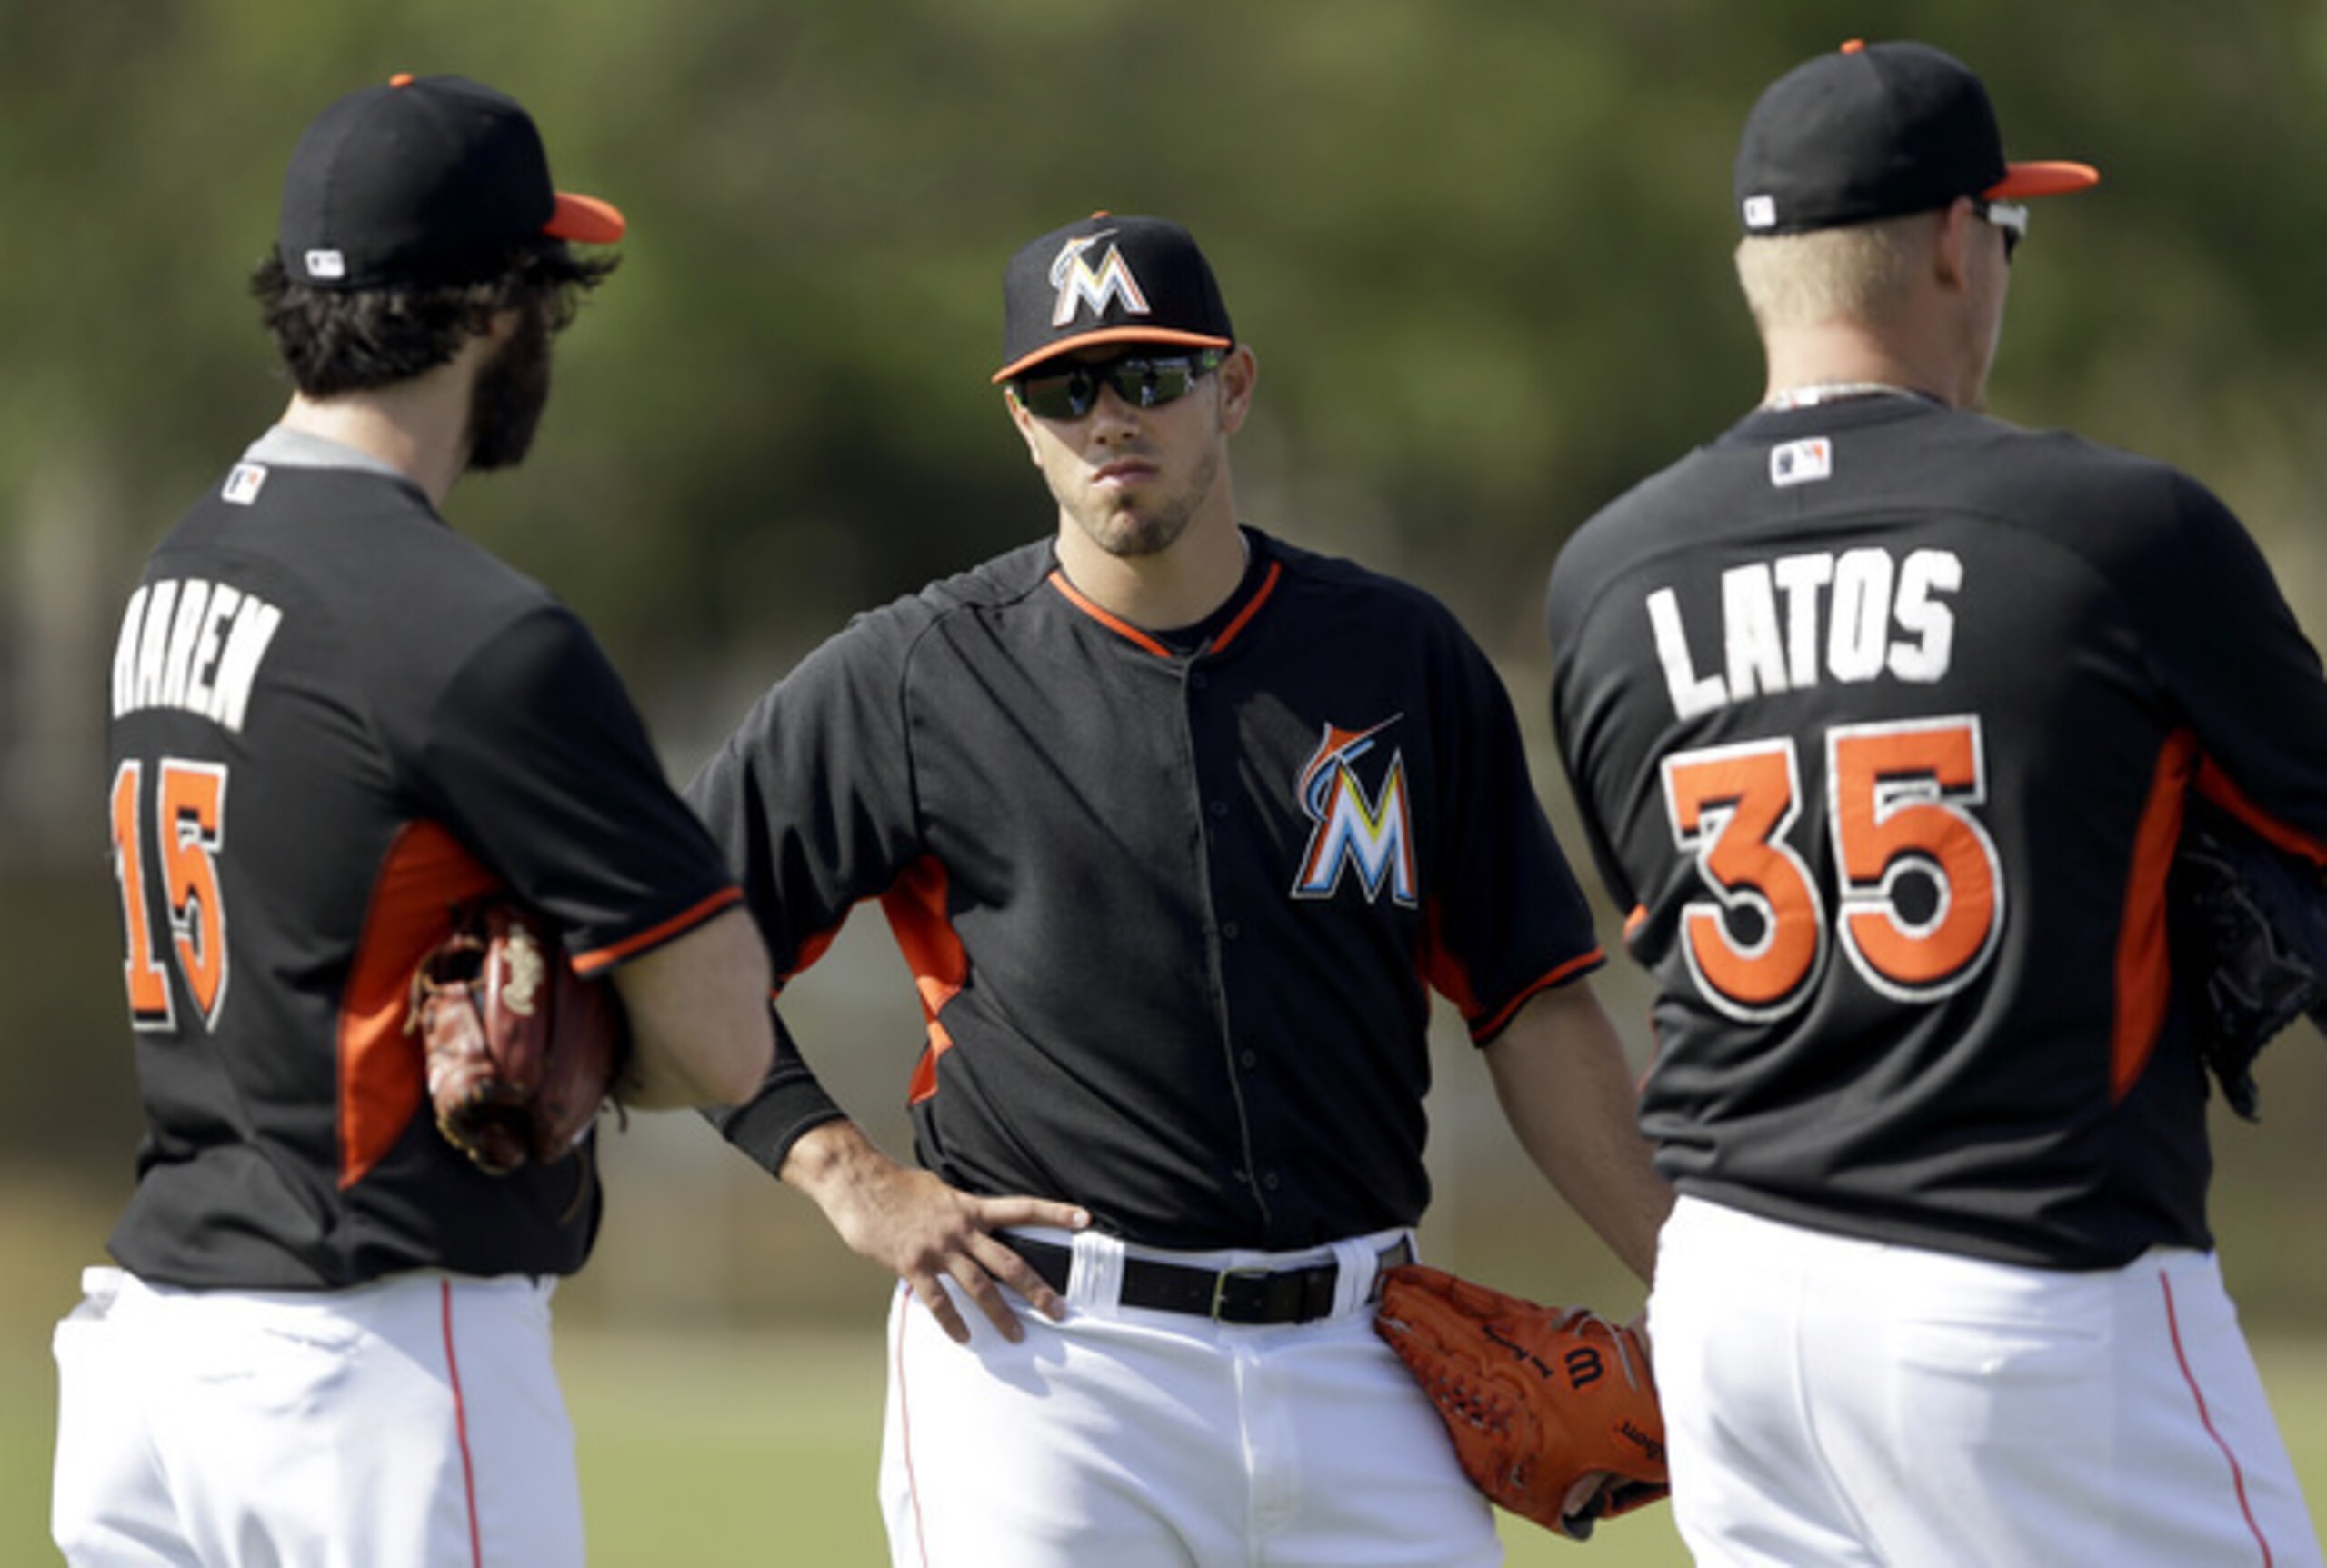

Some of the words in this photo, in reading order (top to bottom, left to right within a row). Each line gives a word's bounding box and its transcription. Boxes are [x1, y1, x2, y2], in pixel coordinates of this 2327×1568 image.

[1646, 547, 1963, 721] LATOS
[110, 756, 229, 1034] 15
[1660, 714, 2005, 1025] 35
